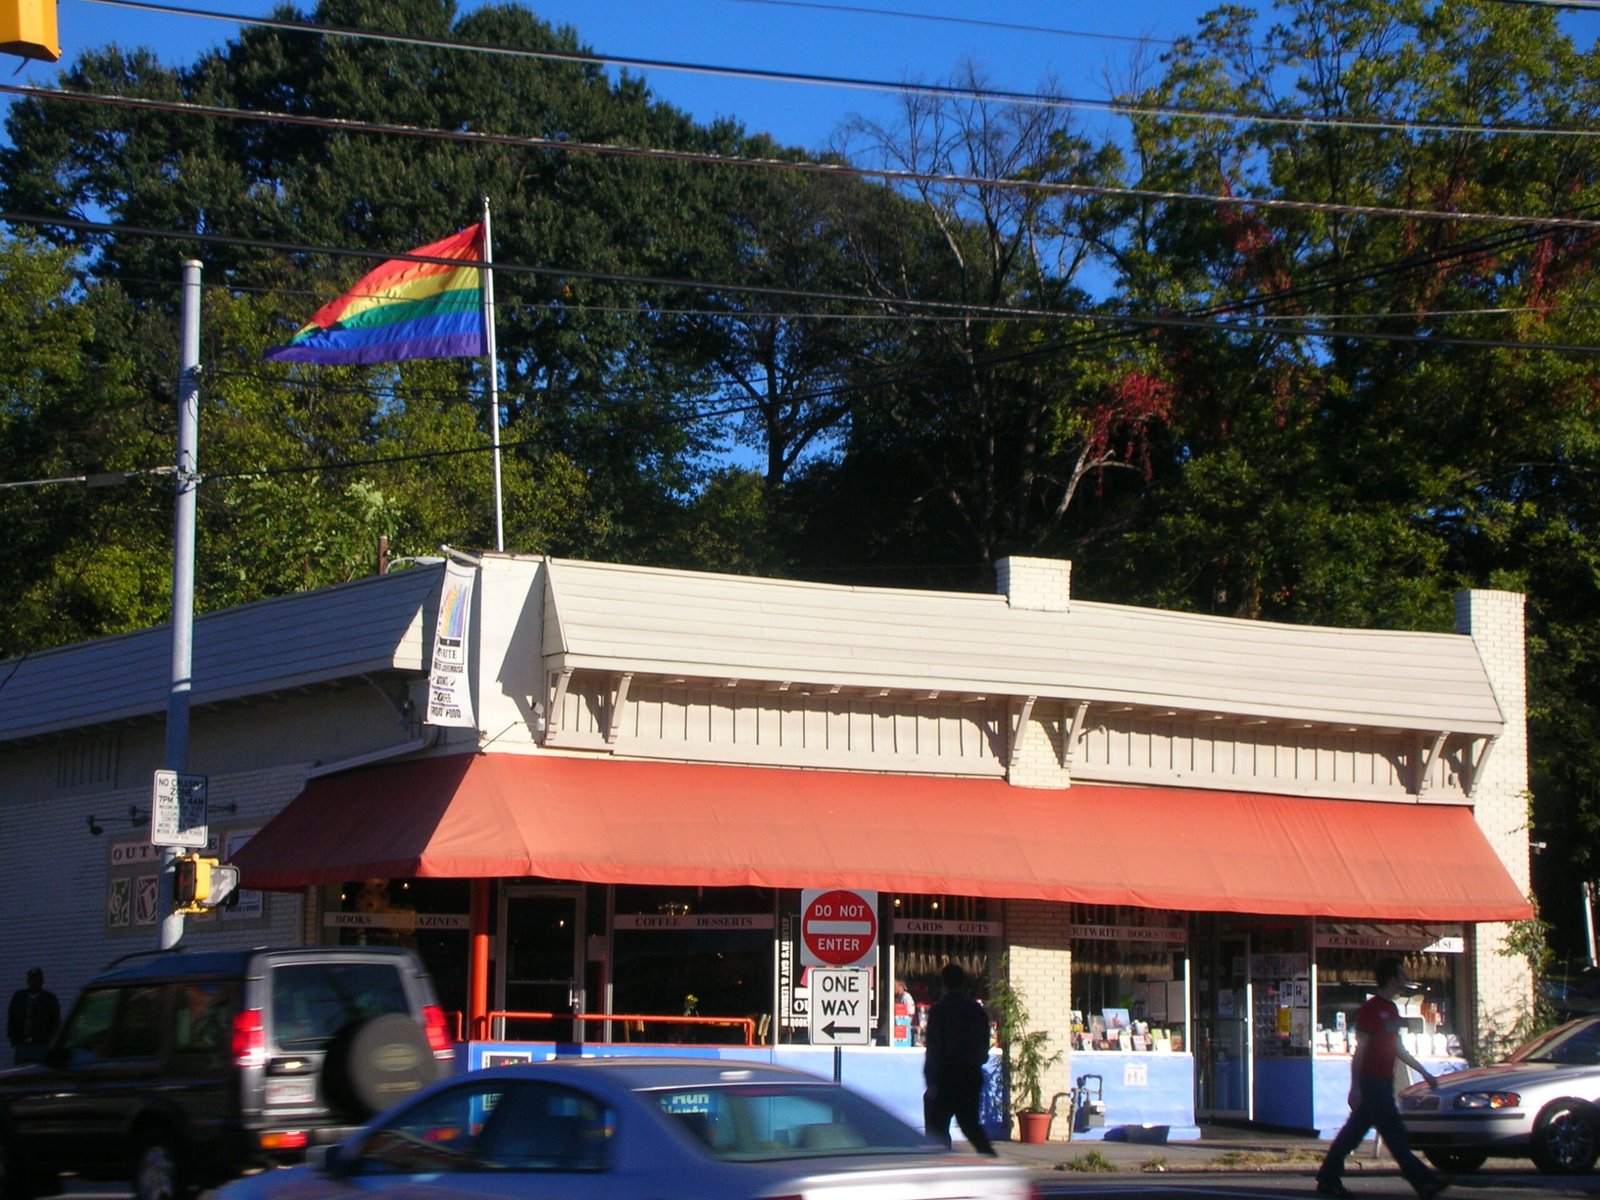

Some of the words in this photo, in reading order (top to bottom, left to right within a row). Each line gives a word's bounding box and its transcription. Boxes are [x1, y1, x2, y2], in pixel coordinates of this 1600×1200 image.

[158, 778, 169, 787] NO
[158, 795, 174, 803] 7PM
[815, 905, 832, 917] DO
[839, 905, 865, 917] NOT
[336, 914, 372, 925] BOOKS
[635, 917, 681, 927] COFFEE
[696, 917, 753, 927] DESSERTS
[907, 921, 944, 932] CARDS
[958, 922, 990, 933] GIFTS
[818, 938, 860, 951] ENTER
[822, 976, 859, 993] ONE
[821, 999, 860, 1017] WAY
